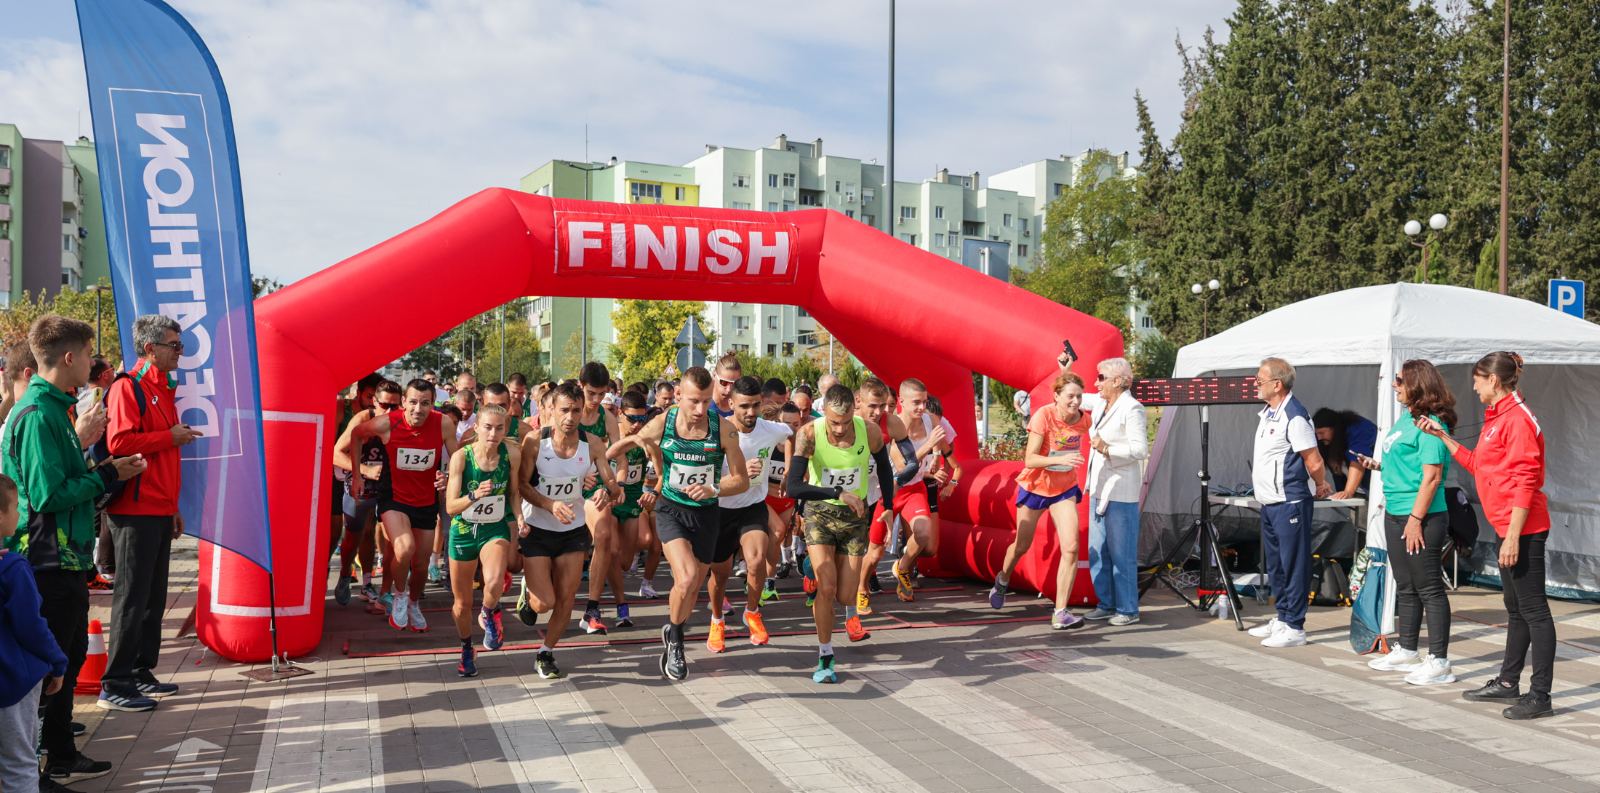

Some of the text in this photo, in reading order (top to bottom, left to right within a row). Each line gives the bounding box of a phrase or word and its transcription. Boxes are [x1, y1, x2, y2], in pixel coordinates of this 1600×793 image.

[567, 220, 790, 275] FINISH
[1557, 285, 1576, 312] P
[404, 454, 430, 465] 134
[673, 452, 706, 461] BULGARIA
[678, 472, 708, 486] 163
[829, 473, 855, 486] 153
[545, 483, 574, 496] 170
[473, 503, 494, 515] 46
